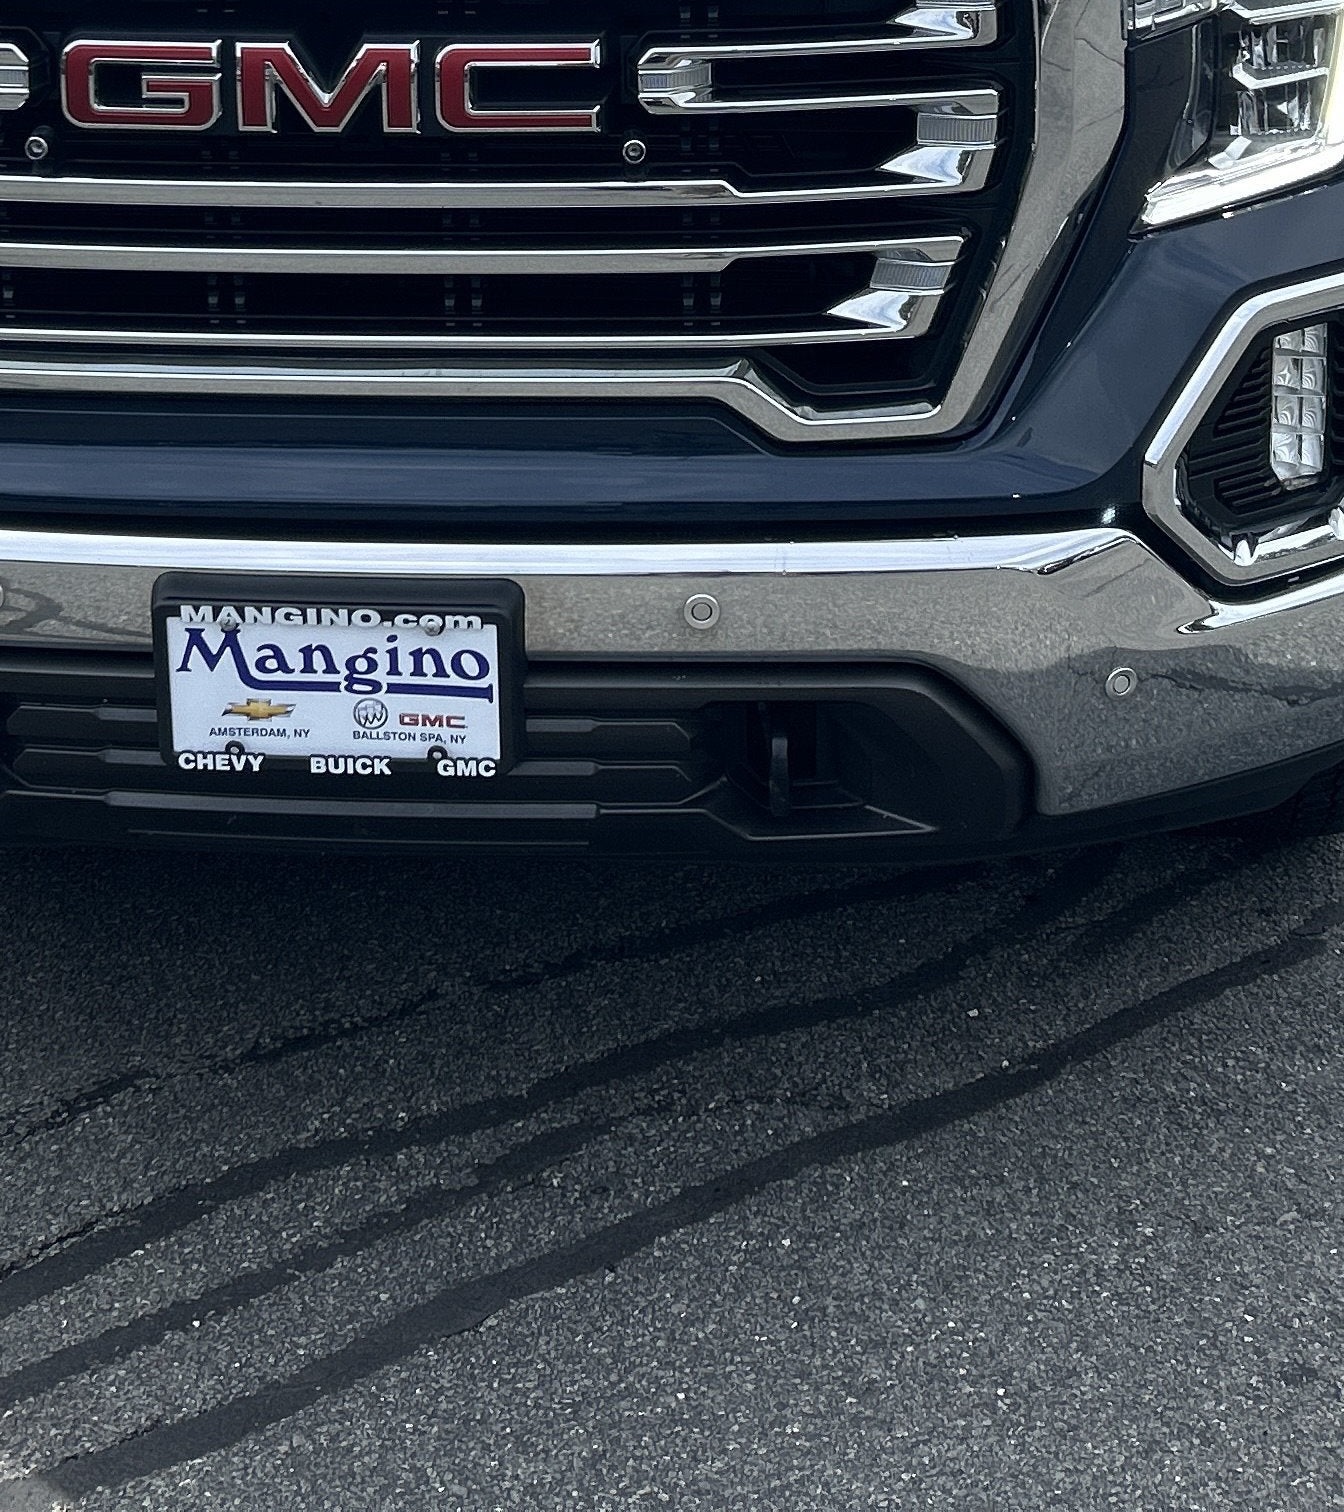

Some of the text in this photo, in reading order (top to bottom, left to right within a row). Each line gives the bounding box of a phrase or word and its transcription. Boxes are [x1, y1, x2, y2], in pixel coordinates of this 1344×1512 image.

[61, 39, 601, 134] GMC
[179, 604, 483, 631] MANGINO.com
[175, 627, 493, 698] Mangino
[208, 727, 311, 739] AMSTERDAM, NY
[398, 712, 466, 729] GMC
[352, 730, 467, 744] BALLSTON SPA, NY
[178, 752, 497, 778] CHEVY BUICK GMC
